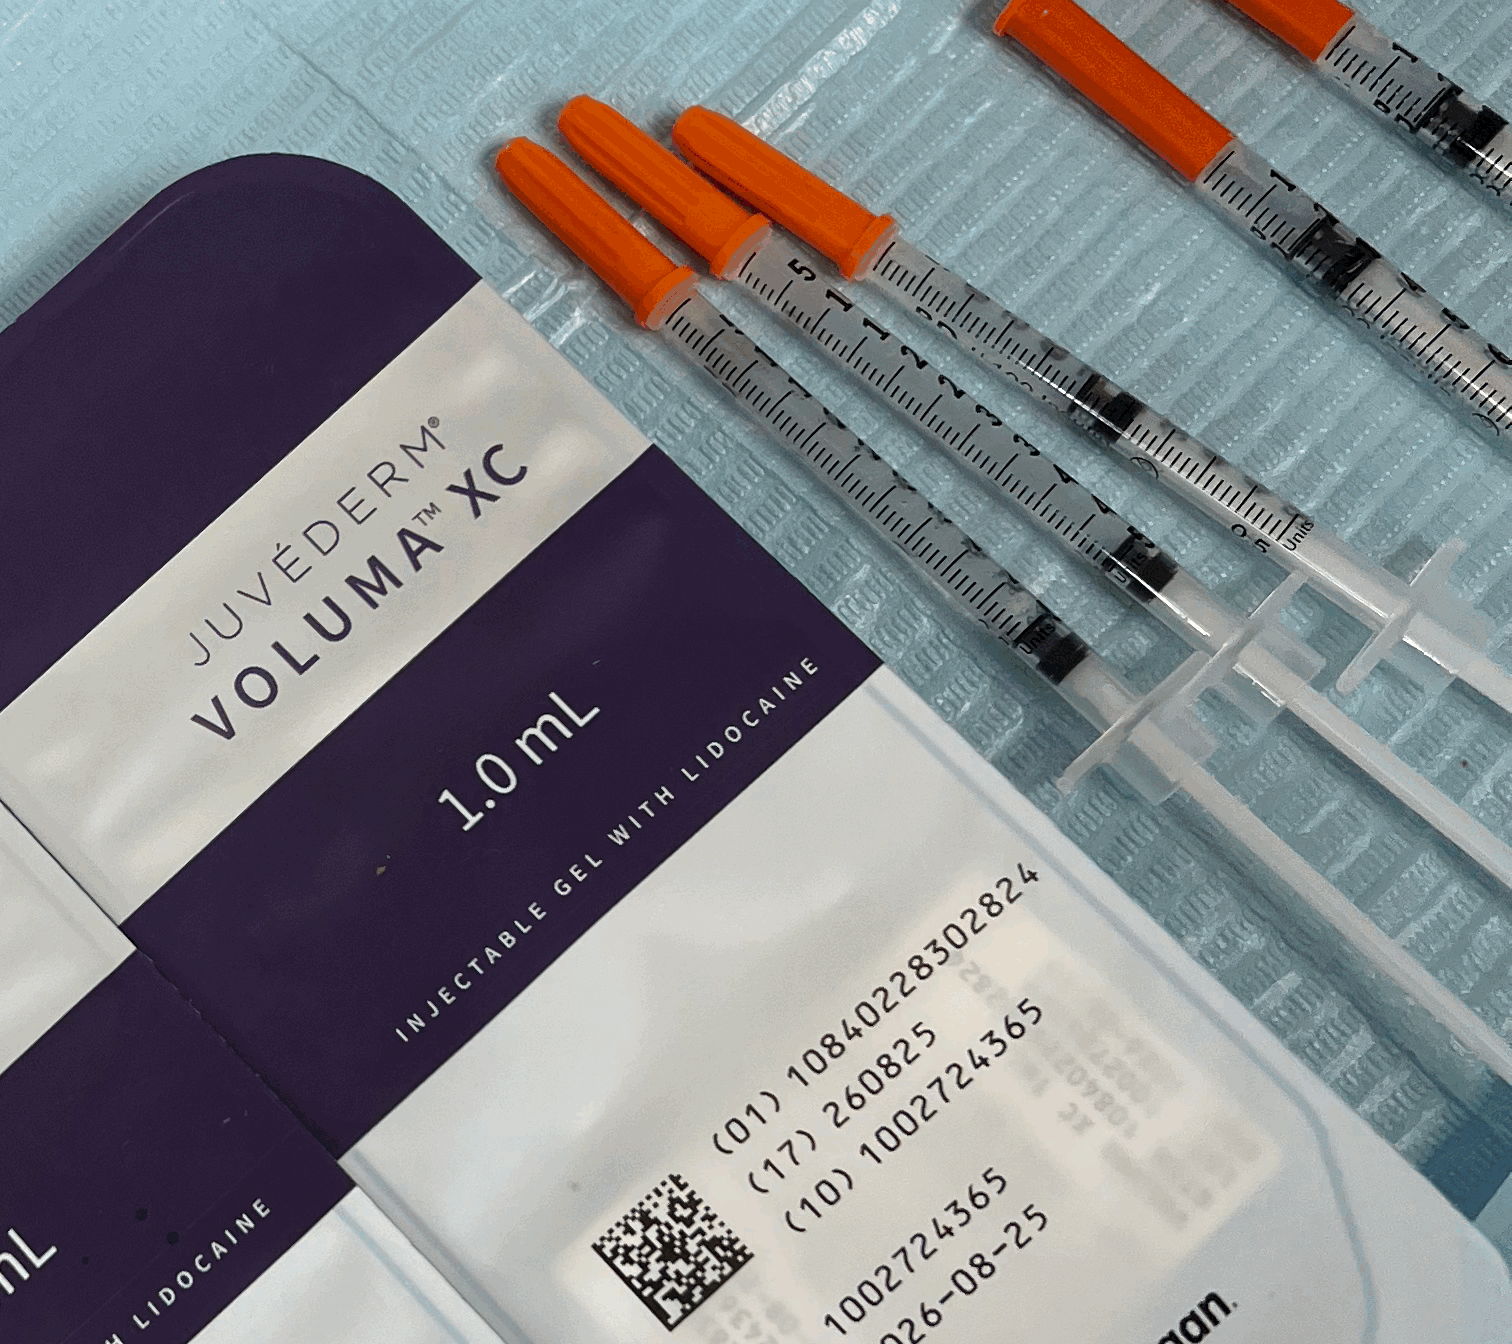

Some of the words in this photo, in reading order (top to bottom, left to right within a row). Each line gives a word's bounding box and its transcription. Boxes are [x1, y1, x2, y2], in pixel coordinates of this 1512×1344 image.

[446, 443, 529, 519] XC
[1282, 519, 1314, 551] Units
[438, 751, 518, 832] 1.0
[515, 692, 601, 766] mL
[395, 901, 547, 1043] INJECTABLE
[553, 853, 602, 897] GEL
[606, 786, 675, 847] WITH
[681, 655, 818, 781] LIDOCAINE
[712, 1089, 781, 1156] (01)
[786, 862, 1041, 1088] 10840228302824
[748, 1128, 816, 1195] (17)
[822, 1022, 937, 1128] 260825
[785, 1166, 855, 1234] (10)
[859, 996, 1045, 1166] 1002724365
[132, 1197, 272, 1330] LIDOCAINE
[823, 1166, 1009, 1337] 1002724365
